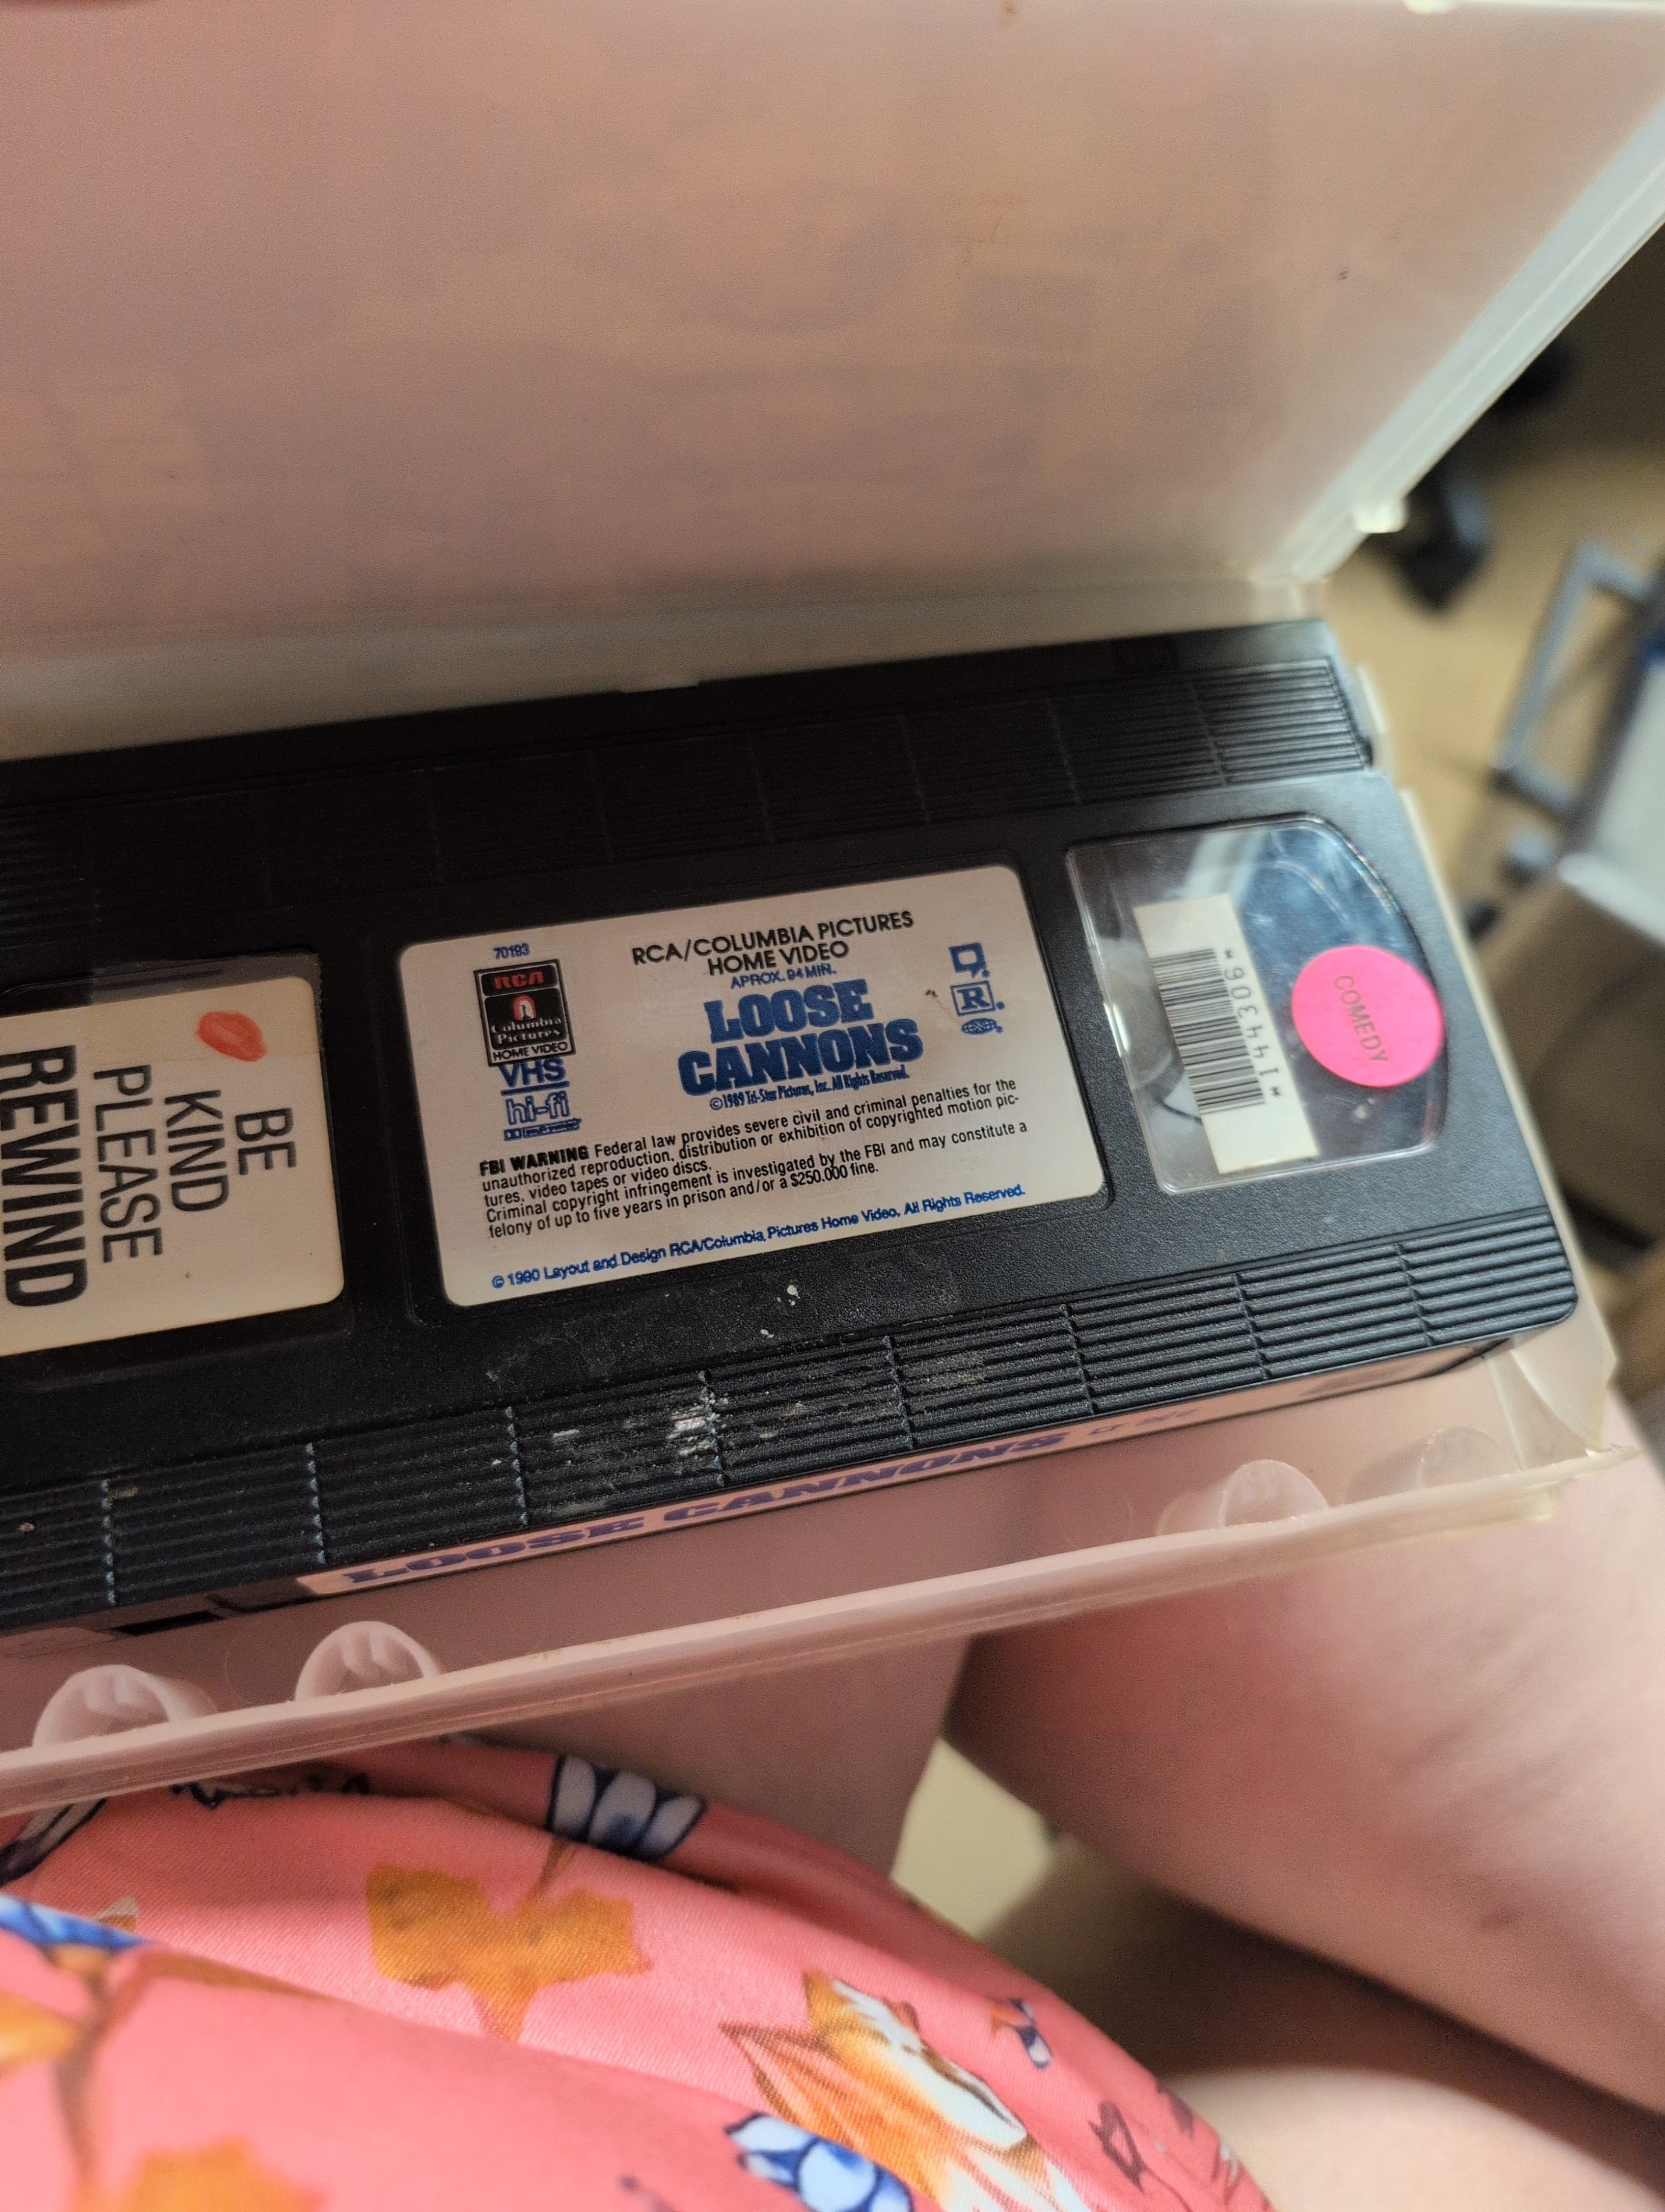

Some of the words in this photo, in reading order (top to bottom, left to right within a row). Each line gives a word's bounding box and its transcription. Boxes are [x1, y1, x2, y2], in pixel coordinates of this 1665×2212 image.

[632, 925, 815, 966] RCA/COLUMBIA
[817, 910, 915, 940] PICTURES
[707, 949, 777, 977] HOME
[778, 940, 850, 966] VIDEO
[493, 968, 546, 991] RCA
[731, 970, 786, 990] APROX.
[804, 962, 837, 979] MIN.
[958, 987, 990, 1011] R
[491, 1015, 562, 1035] Columbia
[496, 1025, 561, 1045] Pictures
[703, 979, 875, 1044] LOOSE
[1333, 974, 1390, 1065] COMEDY
[493, 1047, 529, 1062] HOME
[532, 1041, 569, 1054] VIDEO
[498, 1055, 569, 1090] VHS
[677, 1018, 924, 1097] CANNONS
[831, 1075, 844, 1091] All
[842, 1072, 871, 1091] Rights
[479, 1160, 506, 1177] FBI
[509, 1145, 590, 1172] WARNING
[594, 1136, 647, 1158] Federal
[651, 1135, 676, 1148] law
[681, 1124, 741, 1147] provides
[744, 1116, 789, 1134] severe
[792, 1108, 821, 1126] civil
[825, 1104, 851, 1121] and
[853, 1094, 907, 1116] criminal
[911, 1086, 970, 1110] penalties
[973, 1083, 991, 1096] for
[995, 1079, 1016, 1092] the
[505, 1091, 571, 1125] hi-fi
[94, 1064, 163, 1263] PLEASE
[165, 1090, 229, 1212] KIND
[235, 1108, 297, 1175] BE
[481, 1165, 576, 1192] unauthorized
[678, 1137, 757, 1160] distribution
[760, 1135, 774, 1146] or
[778, 1122, 845, 1143] exhibition
[848, 1118, 862, 1132] of
[866, 1105, 944, 1129] copyrighted
[947, 1098, 993, 1115] motion
[996, 1094, 1019, 1109] pic-
[486, 1200, 547, 1223] Criminal
[552, 1188, 620, 1212] copyright
[624, 1172, 713, 1200] infringement
[715, 1171, 729, 1184] is
[732, 1155, 817, 1183] investigated
[819, 1154, 838, 1170] by
[839, 1149, 862, 1163] the
[864, 1143, 886, 1159] FBI
[890, 1139, 915, 1154] and
[918, 1136, 946, 1150] may
[951, 1123, 1015, 1144] constitute
[1019, 1122, 1028, 1133] a
[0, 1045, 88, 1307] REWIND
[488, 1221, 533, 1239] felony
[537, 1215, 551, 1231] of
[554, 1214, 572, 1229] up
[575, 1211, 590, 1224] to
[593, 1206, 620, 1221] five
[622, 1199, 663, 1219] years
[665, 1196, 679, 1208] in
[682, 1187, 727, 1208] prison
[729, 1179, 775, 1198] and/or
[779, 1178, 788, 1189] a
[849, 1162, 879, 1176] fine.
[528, 1183, 568, 1200] video
[570, 1175, 610, 1194] tapes
[612, 1174, 627, 1186] or
[630, 1167, 669, 1183] video
[672, 1160, 712, 1176] discs.
[543, 1260, 591, 1280] Layout
[593, 1253, 619, 1271] and
[620, 1247, 667, 1266] Design
[767, 1221, 820, 1239] Pictures
[820, 1214, 860, 1230] Home
[904, 1201, 920, 1215] All
[922, 1196, 962, 1213] Rights
[962, 1183, 1026, 1205] Reserved.
[663, 1432, 1069, 1522] CANNONS
[345, 1517, 645, 1584] LOOSE
